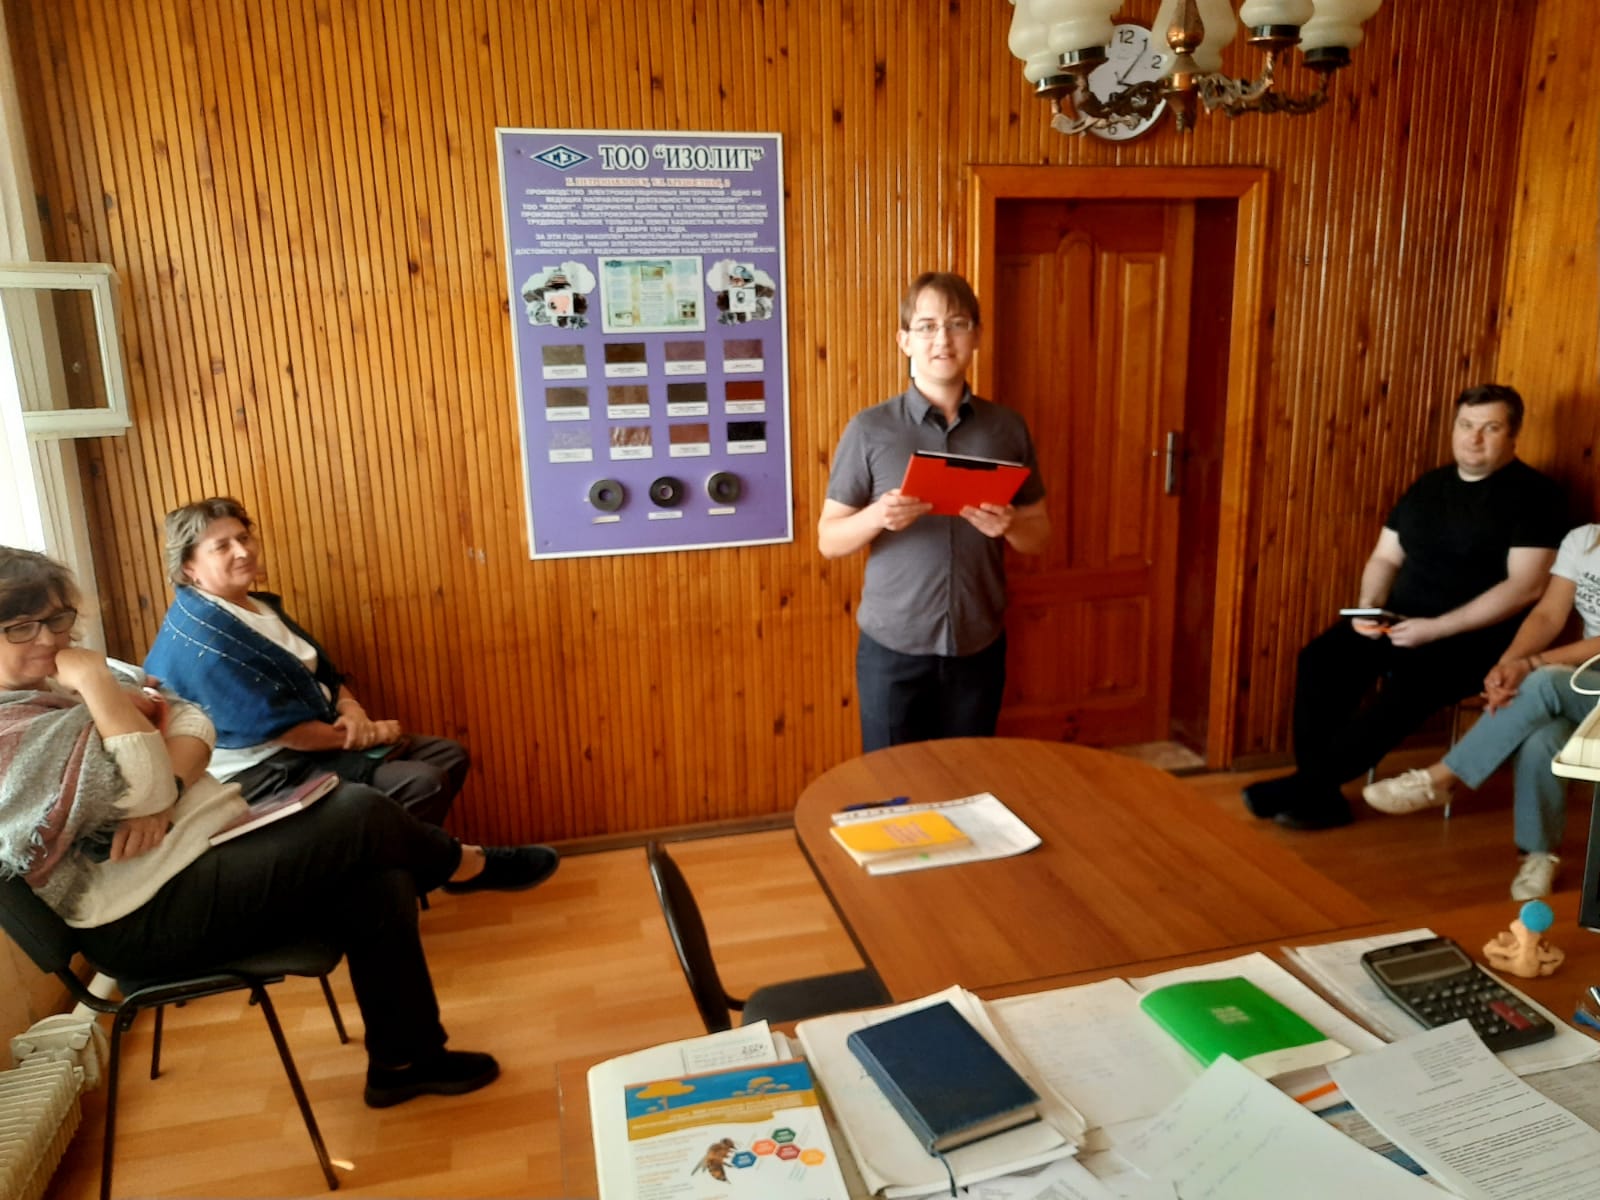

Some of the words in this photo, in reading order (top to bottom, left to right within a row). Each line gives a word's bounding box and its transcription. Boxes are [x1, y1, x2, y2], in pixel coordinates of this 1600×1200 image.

[1119, 29, 1134, 44] 12
[1151, 55, 1161, 69] 2
[599, 146, 647, 169] ТОО
